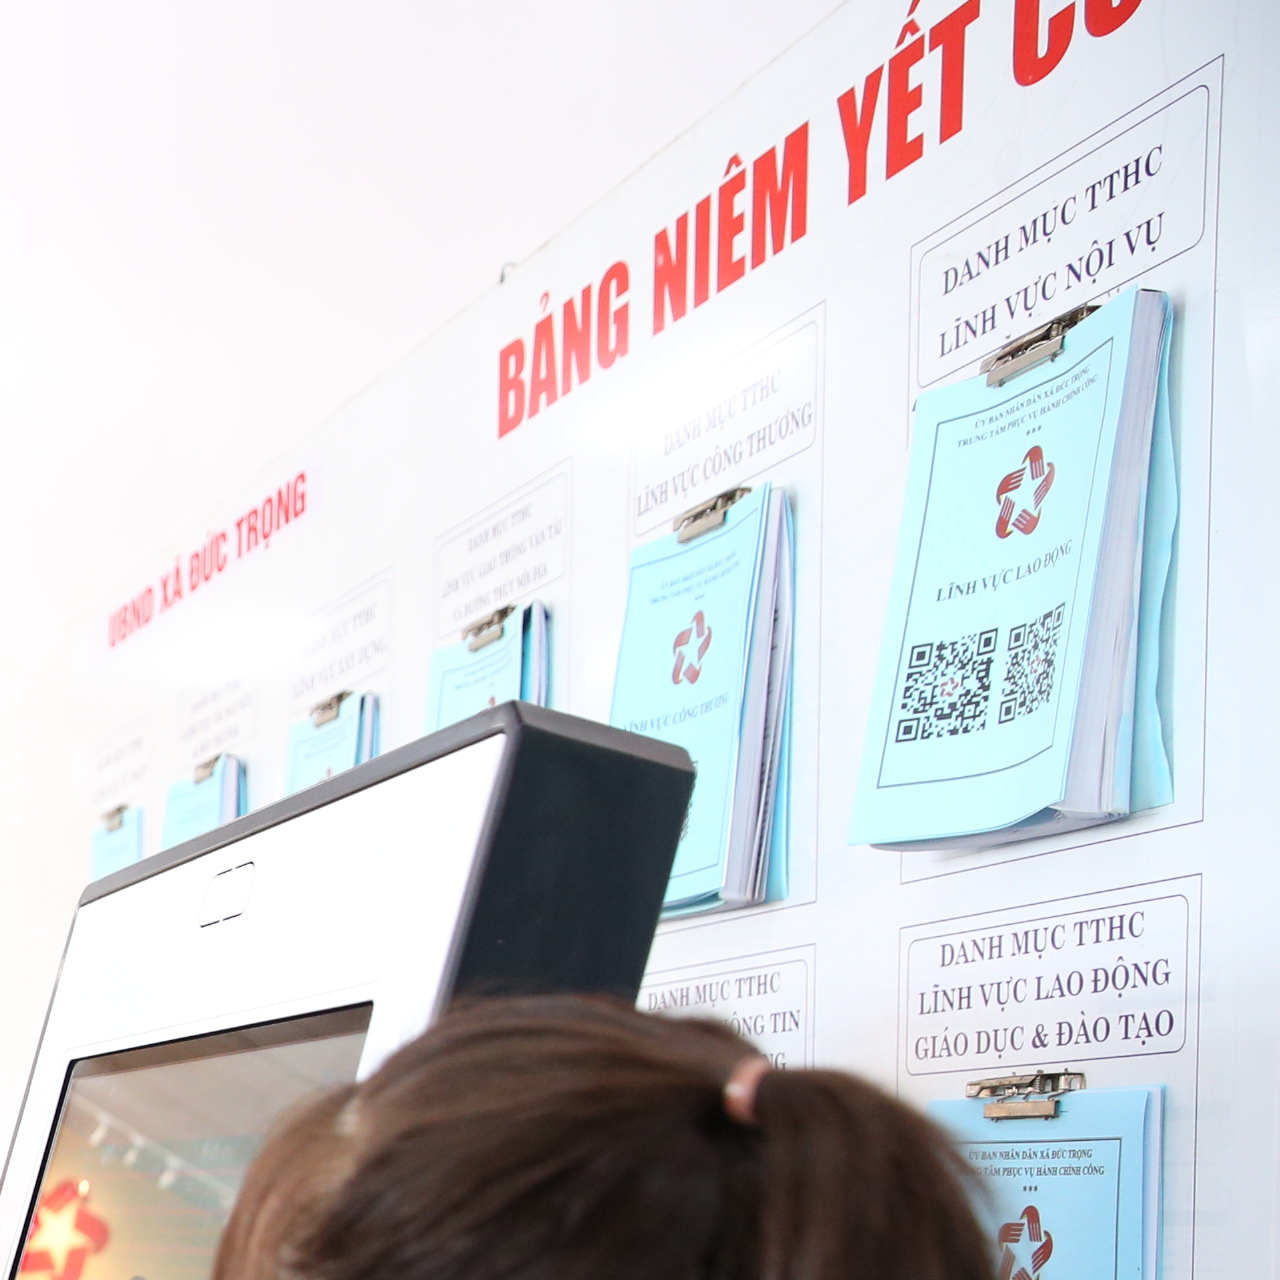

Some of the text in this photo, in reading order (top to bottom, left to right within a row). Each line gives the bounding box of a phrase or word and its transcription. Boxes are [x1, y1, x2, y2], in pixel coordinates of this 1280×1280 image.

[498, 260, 630, 440] BẢNG
[652, 120, 810, 337] NIÊM
[836, 0, 981, 206] YẾT
[943, 144, 1163, 296] DANH MỤC TTHC
[939, 212, 1165, 358] LĨNH VỰC NỘI VỤ
[741, 368, 781, 412] TTHC
[957, 432, 987, 449] TRUNG
[988, 412, 1004, 425] BAN
[637, 401, 813, 517] LĨNH VỰC CÔNG THƯƠNG
[235, 471, 307, 558] TRỌNG
[936, 539, 1073, 602] LĨNH VỰC LAO ĐỘNG
[940, 910, 1146, 968] DANH MỤC TTHC
[647, 971, 781, 1012] DANH MỤC TTHC
[919, 955, 1172, 1015] LĨNH VỰC LAO ĐỘNG
[769, 1009, 801, 1034] TIN
[915, 1009, 1174, 1060] GIÁO DỤC & ĐÀO TẠO
[981, 1149, 998, 1160] BAN
[999, 1147, 1020, 1160] NHÂN
[1022, 1147, 1038, 1160] DÂN
[1039, 1147, 1050, 1160] XÃ
[1051, 1147, 1068, 1160] ĐỨC
[1068, 1148, 1093, 1161] TRỌNG
[1002, 1166, 1023, 1178] PHỤC
[1024, 1166, 1035, 1178] VỤ
[1036, 1164, 1058, 1176] HÀNH
[1058, 1164, 1081, 1176] CHÍNH
[1082, 1163, 1105, 1176] CÔNG
